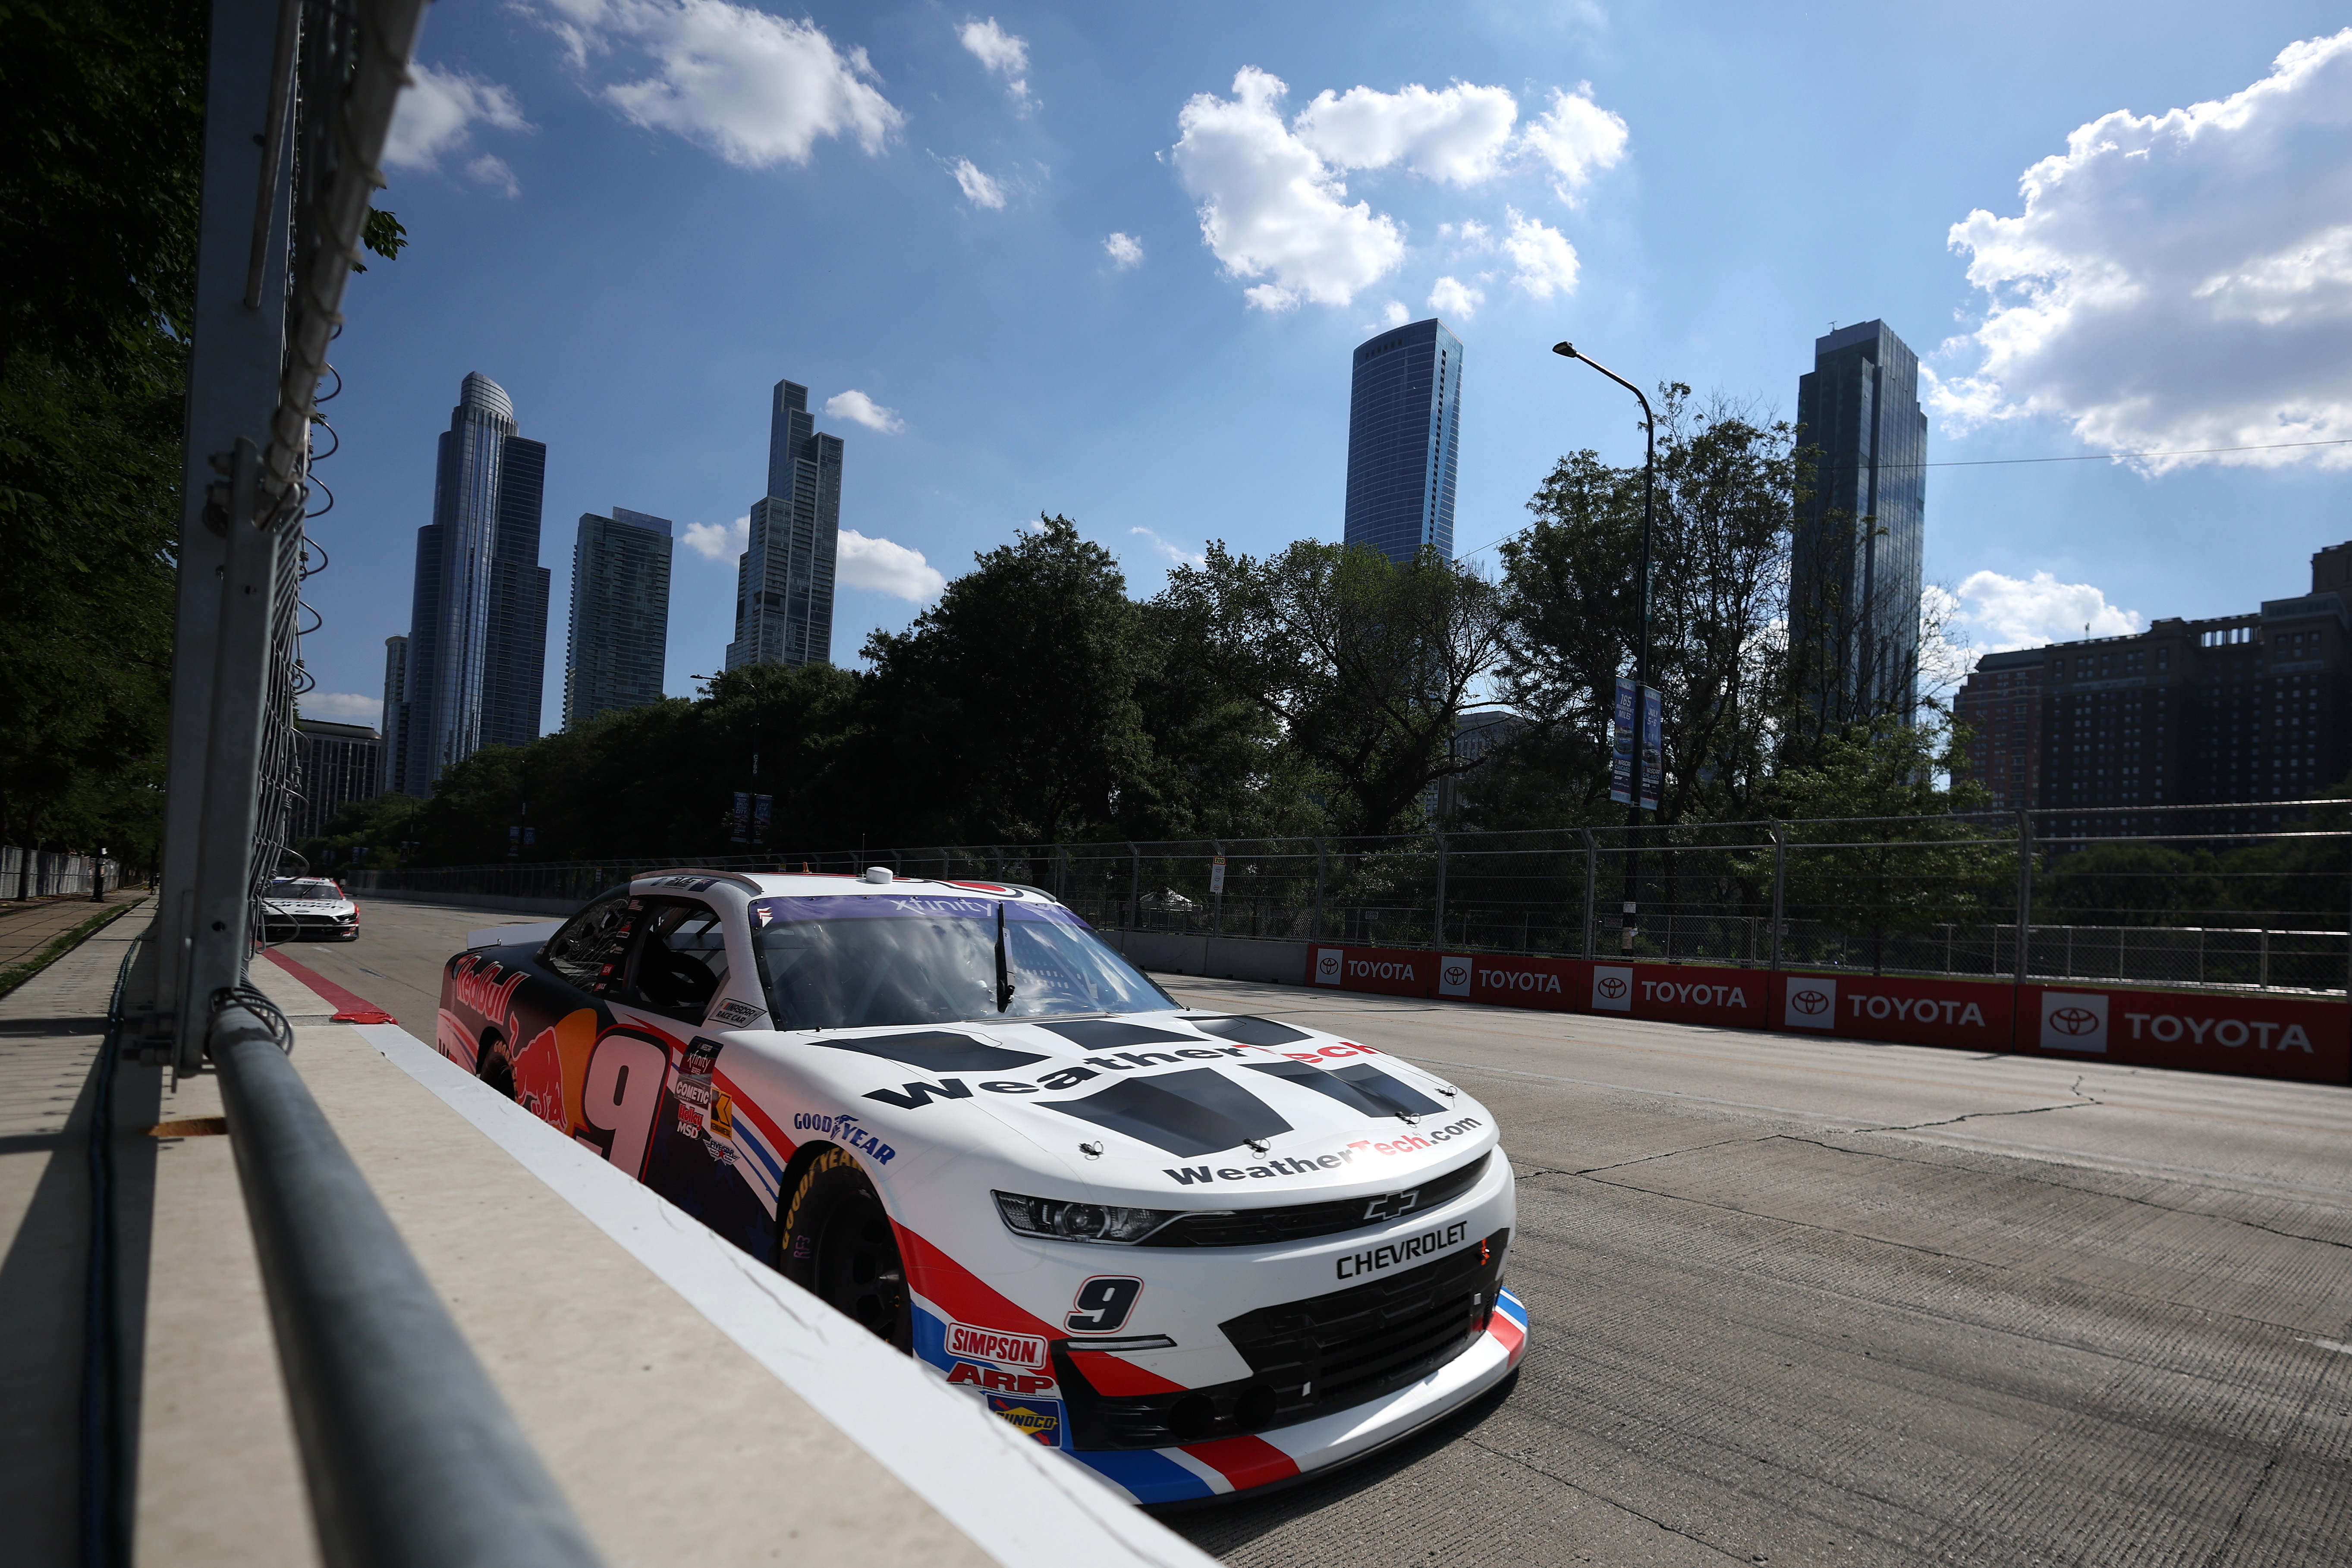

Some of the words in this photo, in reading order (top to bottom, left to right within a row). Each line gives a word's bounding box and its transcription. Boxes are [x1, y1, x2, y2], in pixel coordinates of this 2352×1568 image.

[1620, 694, 1632, 707] 165
[1648, 708, 1659, 718] JULY
[1615, 764, 1630, 773] CHICAGO
[1643, 772, 1660, 780] CHCAGO
[889, 897, 991, 916] xfinity
[1348, 960, 1415, 981] TOYOTA
[1478, 969, 1562, 993] TOYOTA
[1641, 980, 1747, 1008] TOYOTA
[716, 1011, 731, 1020] RACE
[731, 1015, 746, 1024] CAR
[728, 1002, 756, 1017] NASCAR
[1847, 994, 1985, 1027] TOYOTA
[2124, 1012, 2314, 1053] TOYOTA
[687, 1050, 711, 1073] xfinity
[676, 1081, 709, 1104] COMETIC
[575, 1034, 668, 1181] 9
[678, 1103, 704, 1131] Holley
[677, 1121, 698, 1139] MSD
[711, 1141, 723, 1151] FIVE
[1336, 1221, 1468, 1280] CHEVROLET
[1066, 1277, 1142, 1332] 9
[953, 1328, 1037, 1364] SIMPSON
[947, 1362, 1053, 1394] ARP
